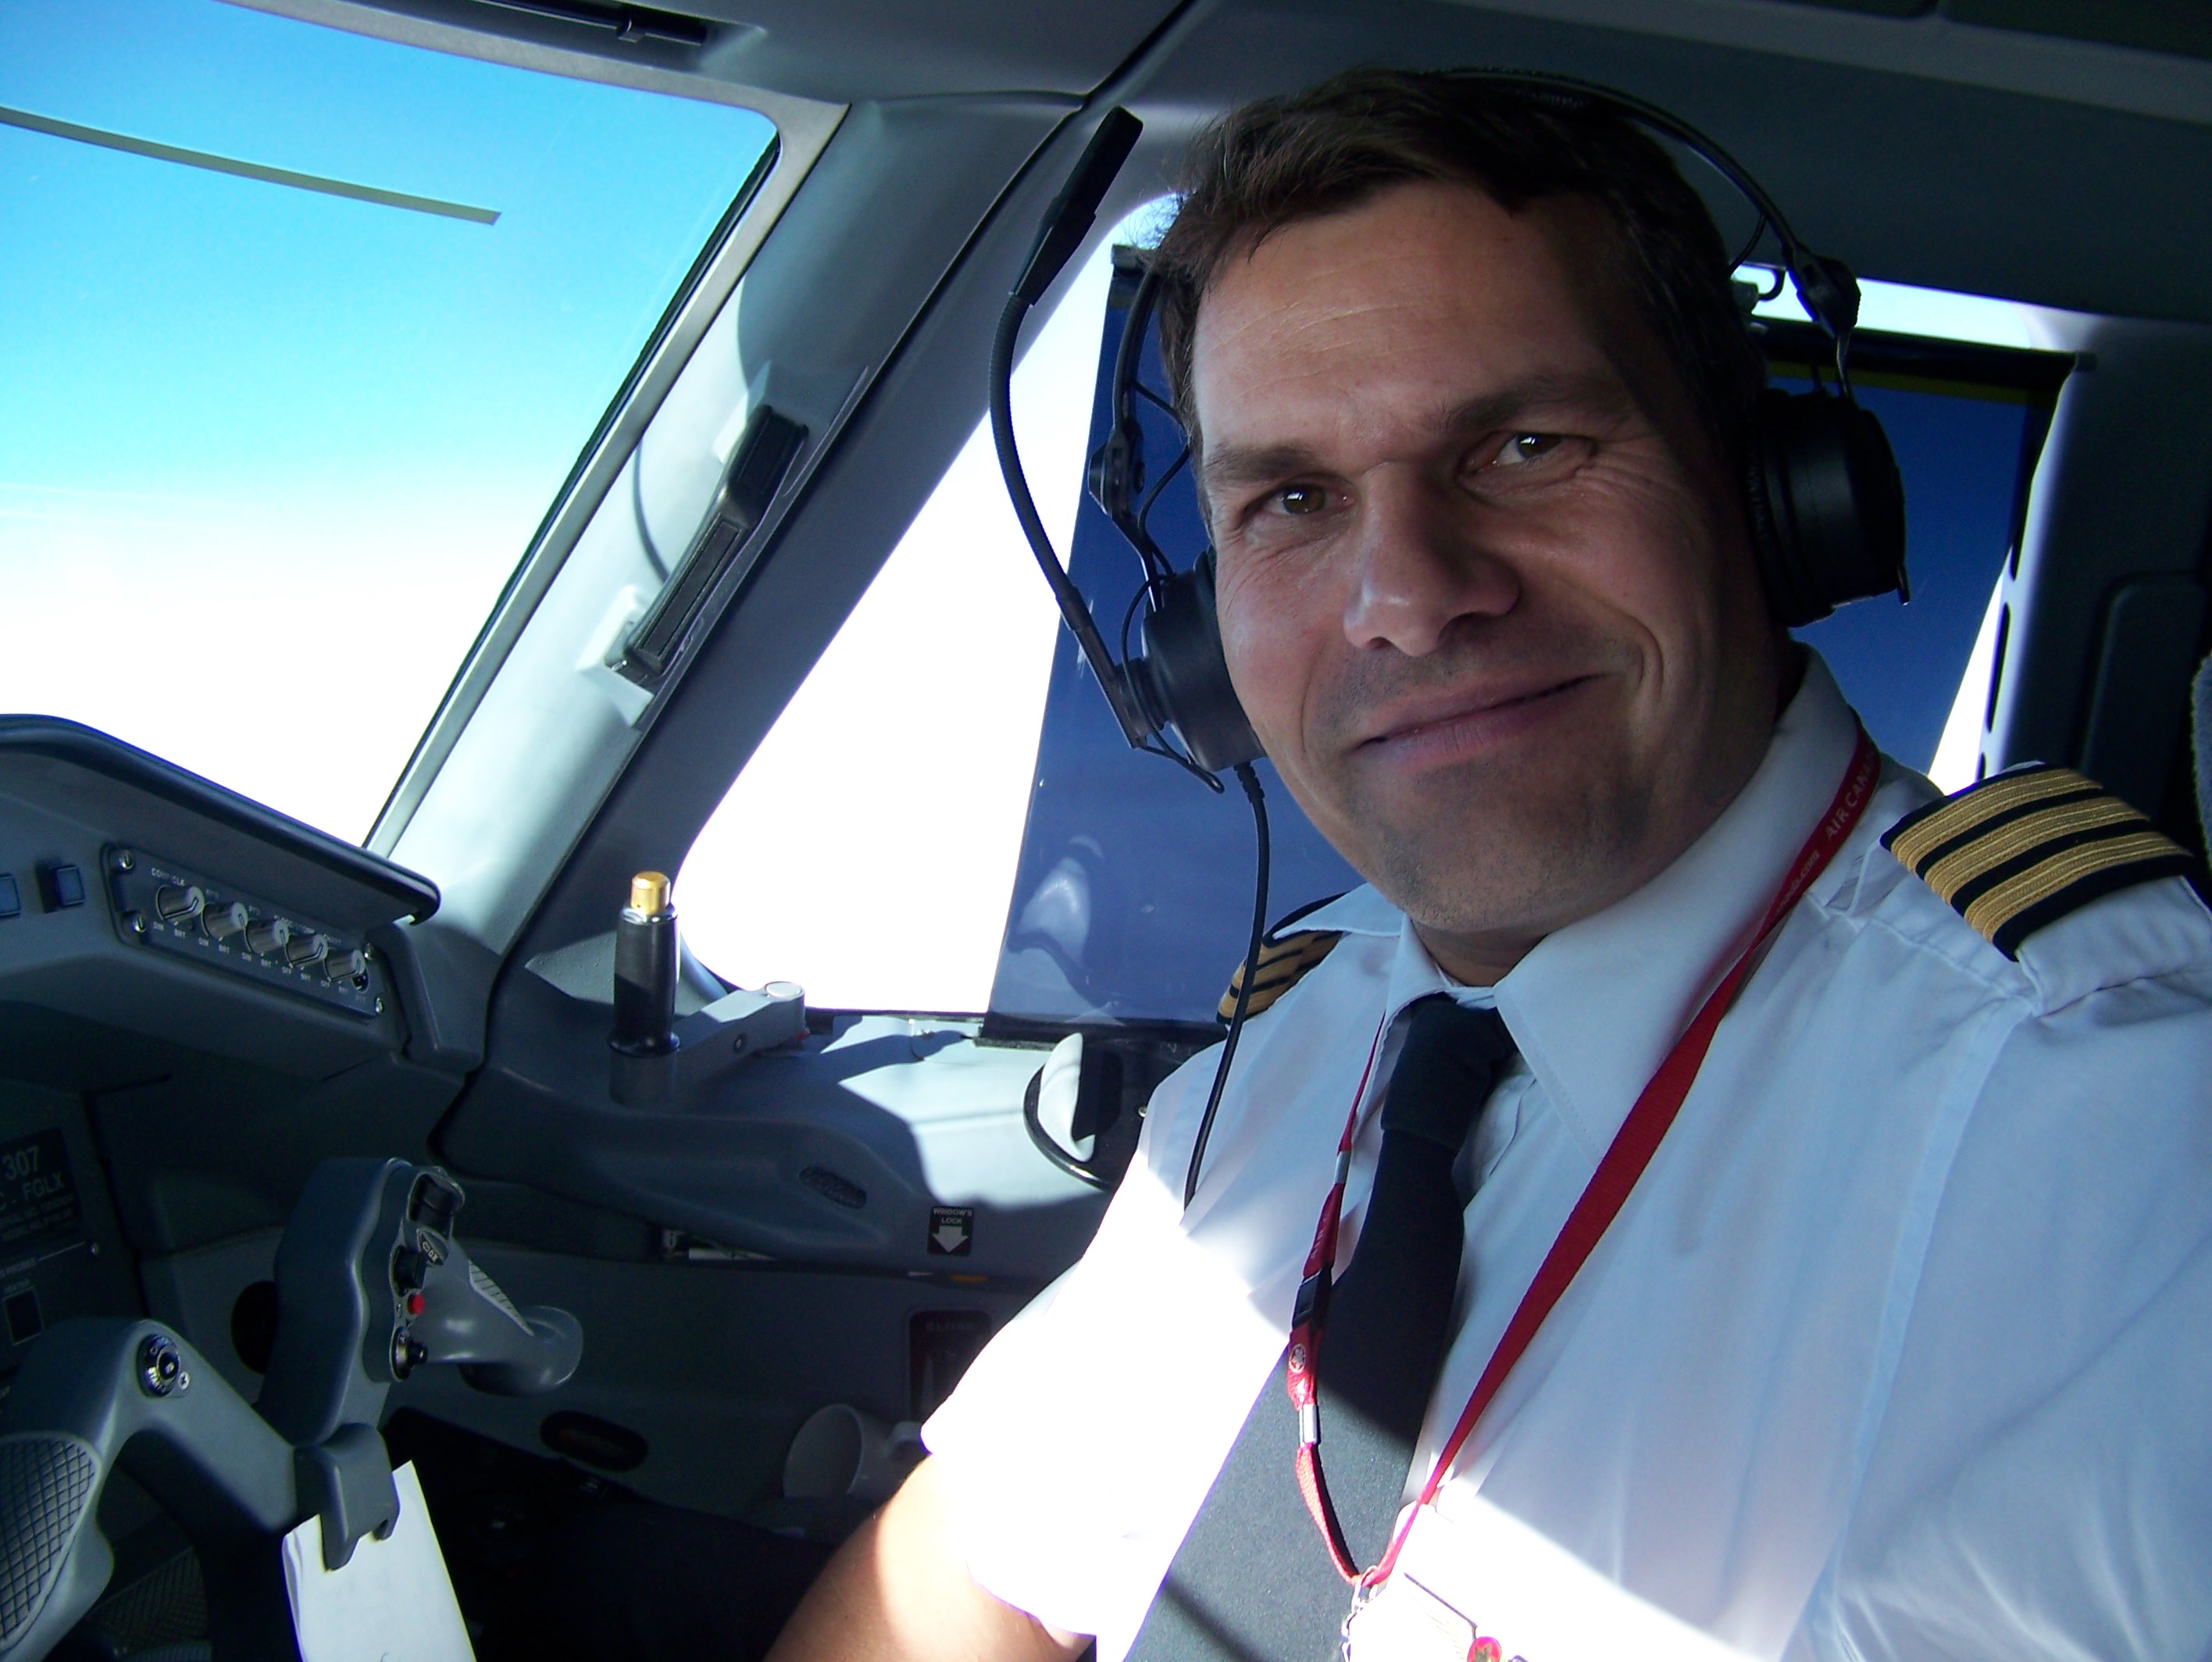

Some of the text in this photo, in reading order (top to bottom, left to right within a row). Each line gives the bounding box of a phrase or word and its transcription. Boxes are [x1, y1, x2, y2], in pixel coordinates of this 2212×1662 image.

[1825, 751, 1875, 840] AIR CANA
[2, 1144, 40, 1181] 307
[21, 1170, 66, 1201] FGLX
